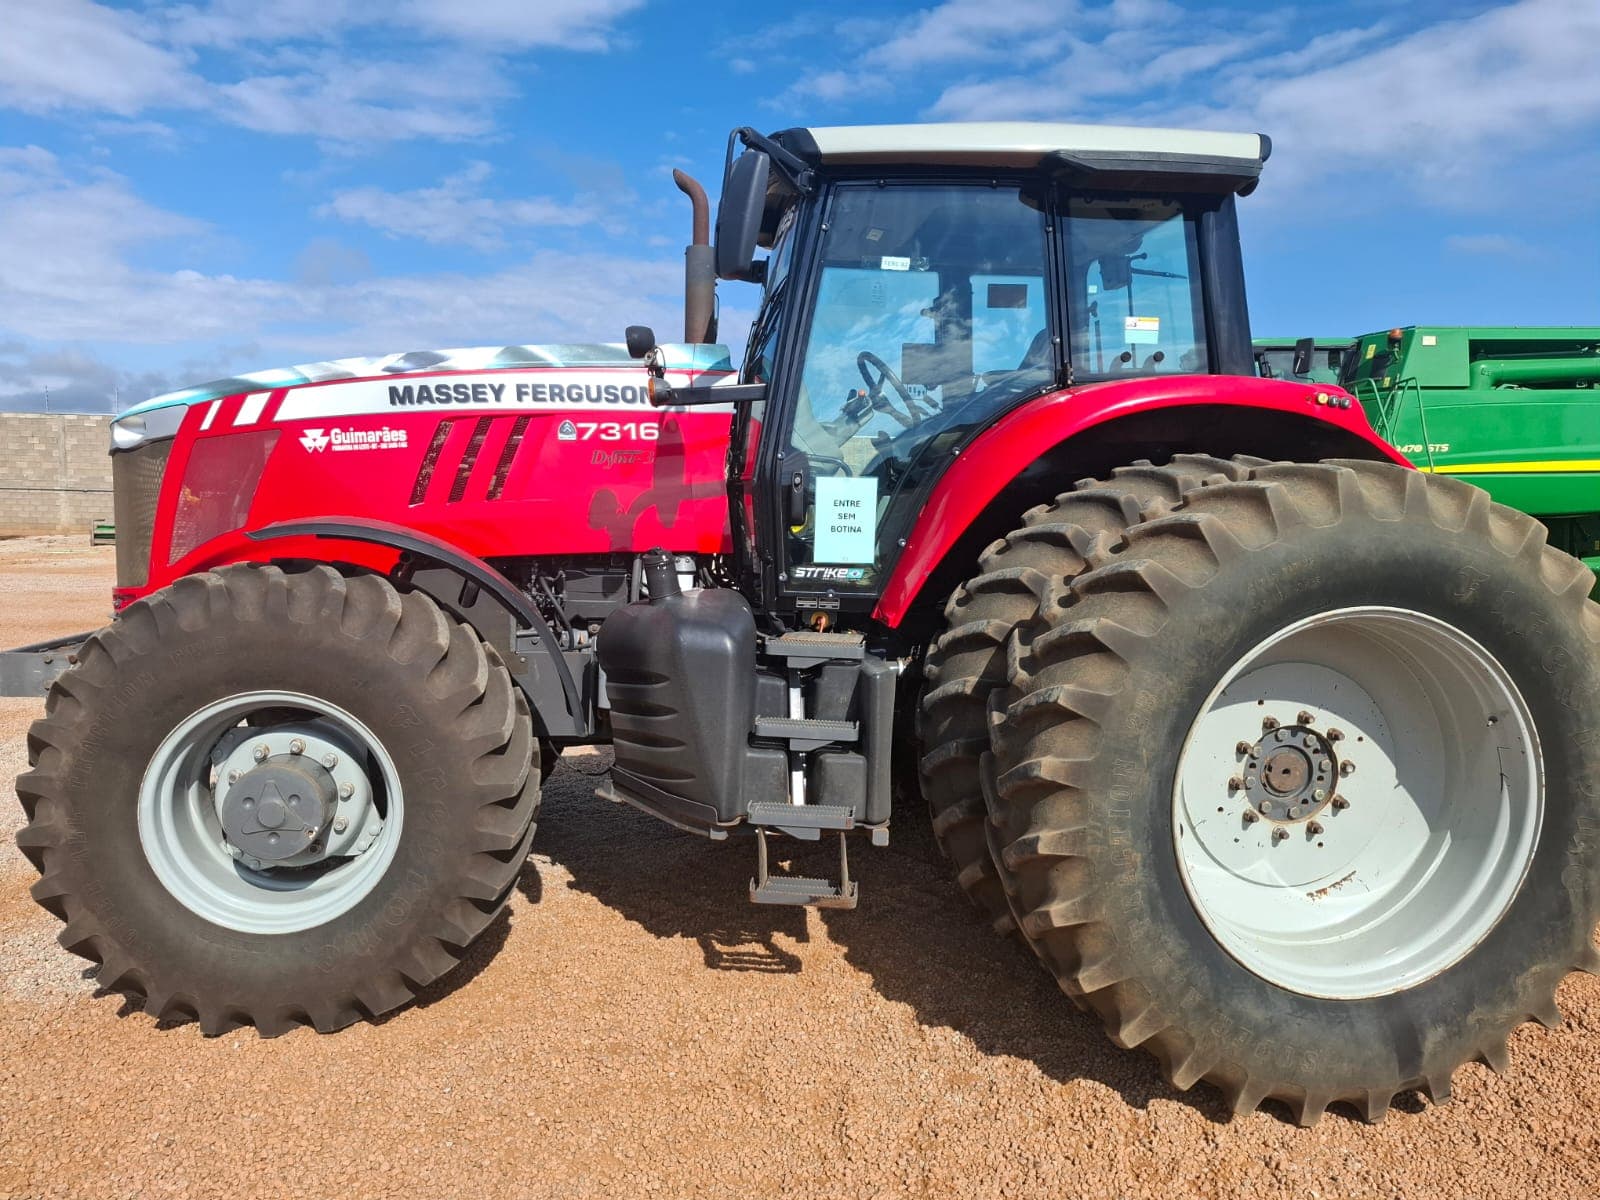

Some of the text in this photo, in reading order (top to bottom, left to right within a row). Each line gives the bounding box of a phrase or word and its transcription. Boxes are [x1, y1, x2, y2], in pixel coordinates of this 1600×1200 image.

[389, 384, 505, 406] MASSEY
[330, 426, 408, 445] Guimarães
[577, 422, 659, 441] 7316
[833, 499, 861, 508] ENTRE
[837, 512, 856, 520] SEM
[830, 525, 862, 534] BOTINA
